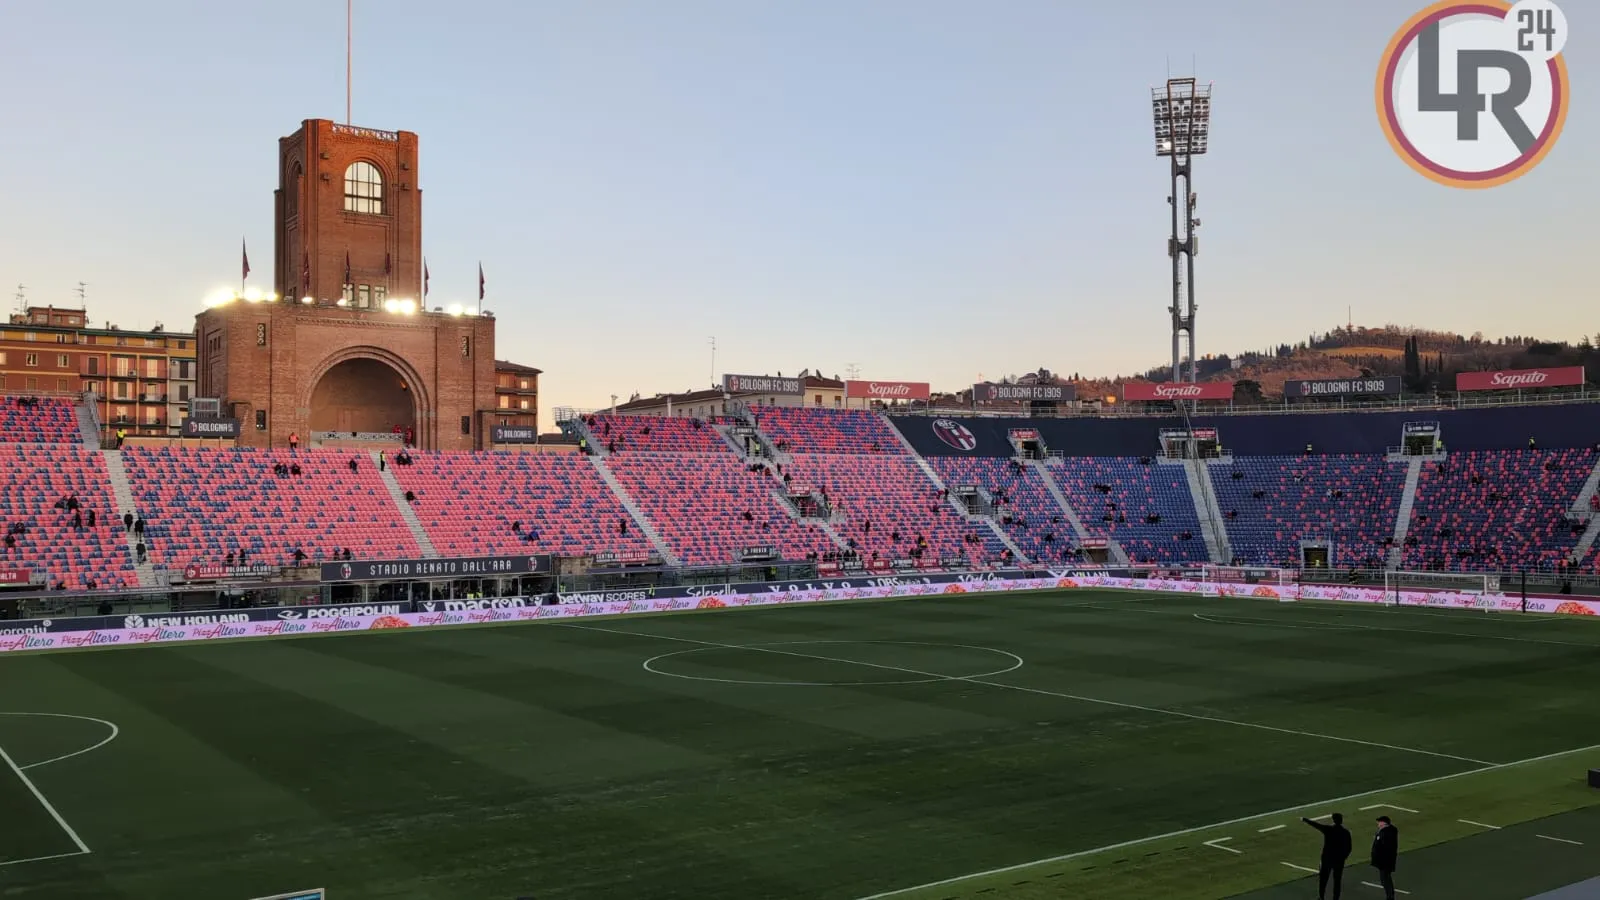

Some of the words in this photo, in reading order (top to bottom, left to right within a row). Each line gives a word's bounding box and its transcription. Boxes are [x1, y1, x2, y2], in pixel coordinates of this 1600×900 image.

[739, 377, 771, 391] BOLOGNA
[772, 379, 781, 392] FC
[782, 380, 799, 392] 1909
[1312, 381, 1350, 394] BOLOGNA
[1352, 380, 1363, 393] FC
[1364, 379, 1385, 392] 1909
[1490, 371, 1549, 388] Saputo
[867, 382, 911, 398] Saputo
[998, 387, 1031, 398] BOLOGNA
[1033, 387, 1043, 398] FC
[1044, 387, 1062, 398] 1909
[1152, 384, 1203, 399] Saputo
[198, 422, 228, 432] BOLOGNA
[370, 563, 409, 576] STADIO
[416, 561, 456, 574] RENATO
[462, 559, 512, 572] DALL'ARA
[444, 597, 526, 612] macron
[557, 592, 604, 604] betway
[606, 591, 646, 602] SCORES
[307, 604, 400, 619] POGGIPOLINI
[418, 611, 463, 625] PizzAltero
[467, 608, 512, 622] PizzAltero
[147, 616, 182, 628] NEW
[184, 613, 250, 626] HOLLAND
[254, 619, 306, 634] PizzAltero
[311, 616, 361, 631] PizzAltero
[61, 630, 120, 646] PizzAltero
[129, 626, 185, 642] PizzAltero
[192, 623, 247, 639] PizzAltero
